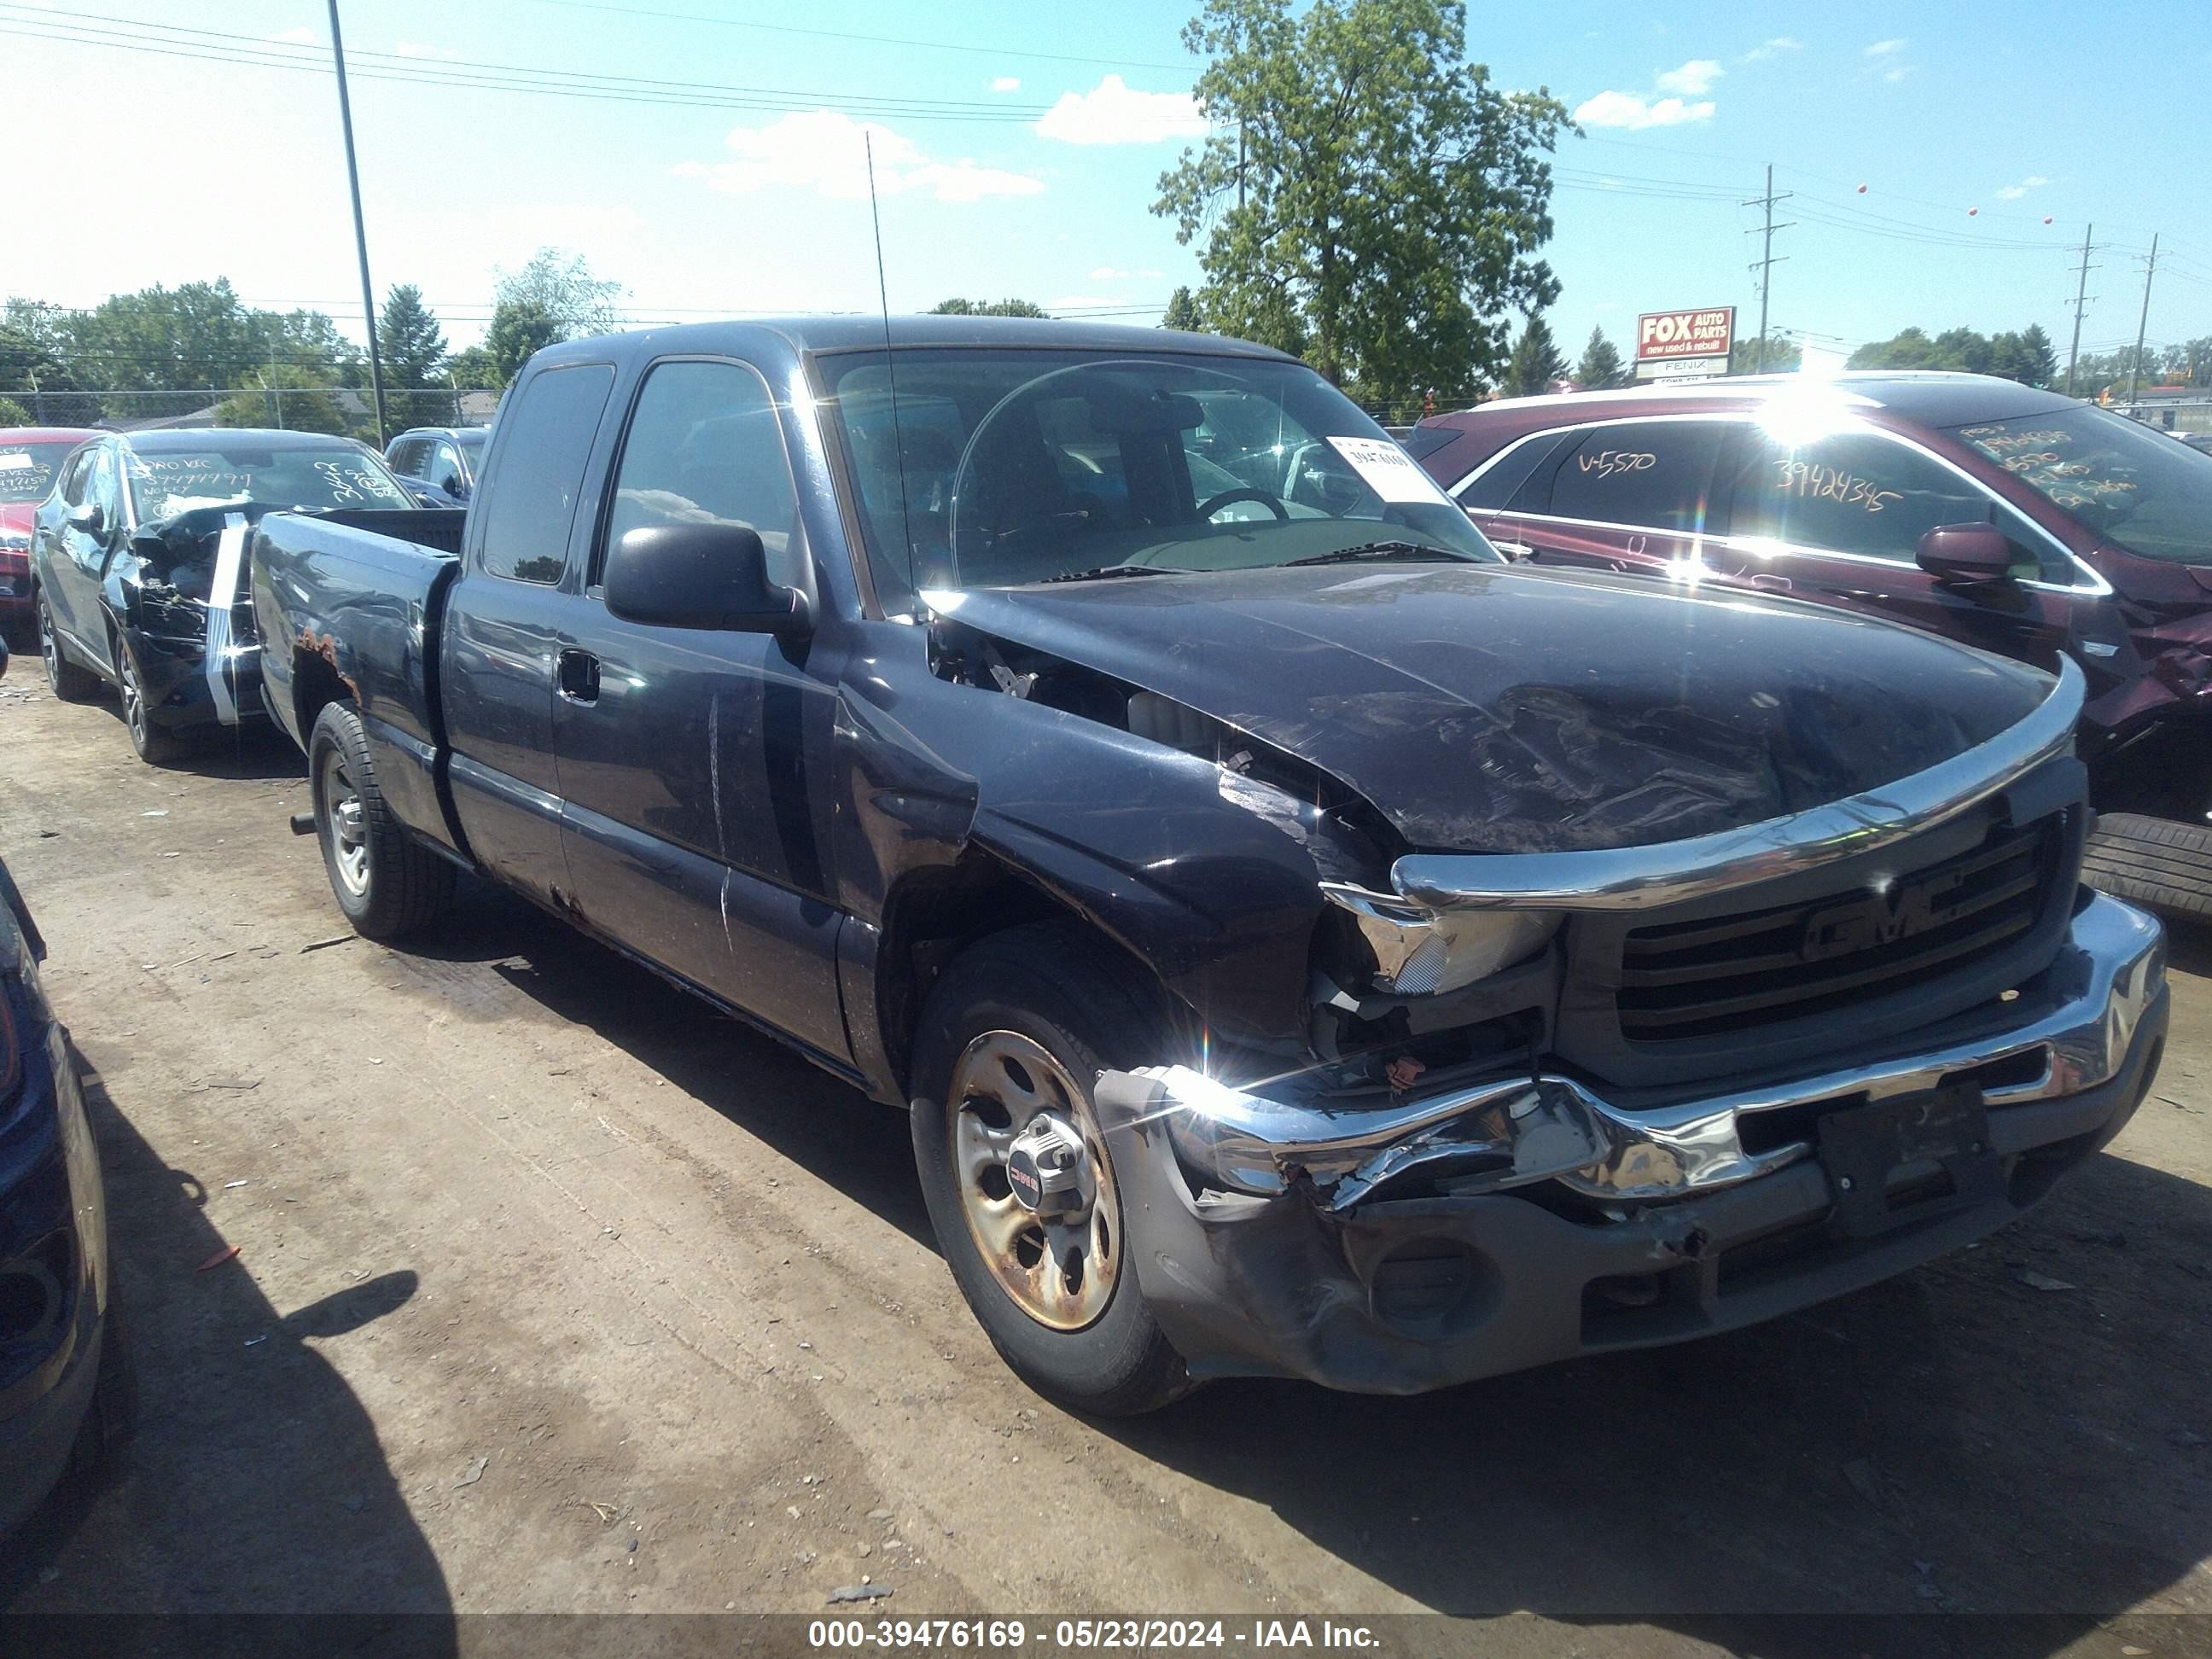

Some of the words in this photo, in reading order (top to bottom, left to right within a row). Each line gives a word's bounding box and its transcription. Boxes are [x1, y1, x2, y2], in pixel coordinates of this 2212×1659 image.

[1642, 314, 1693, 344] FOX
[1694, 312, 1724, 326] AUTO
[1694, 325, 1726, 339] PARTS
[1646, 345, 1664, 355] new
[1666, 342, 1685, 352] used
[1685, 341, 1693, 352] &
[1694, 340, 1720, 351] rebuilt
[183, 459, 212, 469] VIC
[1773, 459, 1906, 512] 39424345
[1803, 869, 1963, 961] GMC
[1010, 1167, 1039, 1193] GMC
